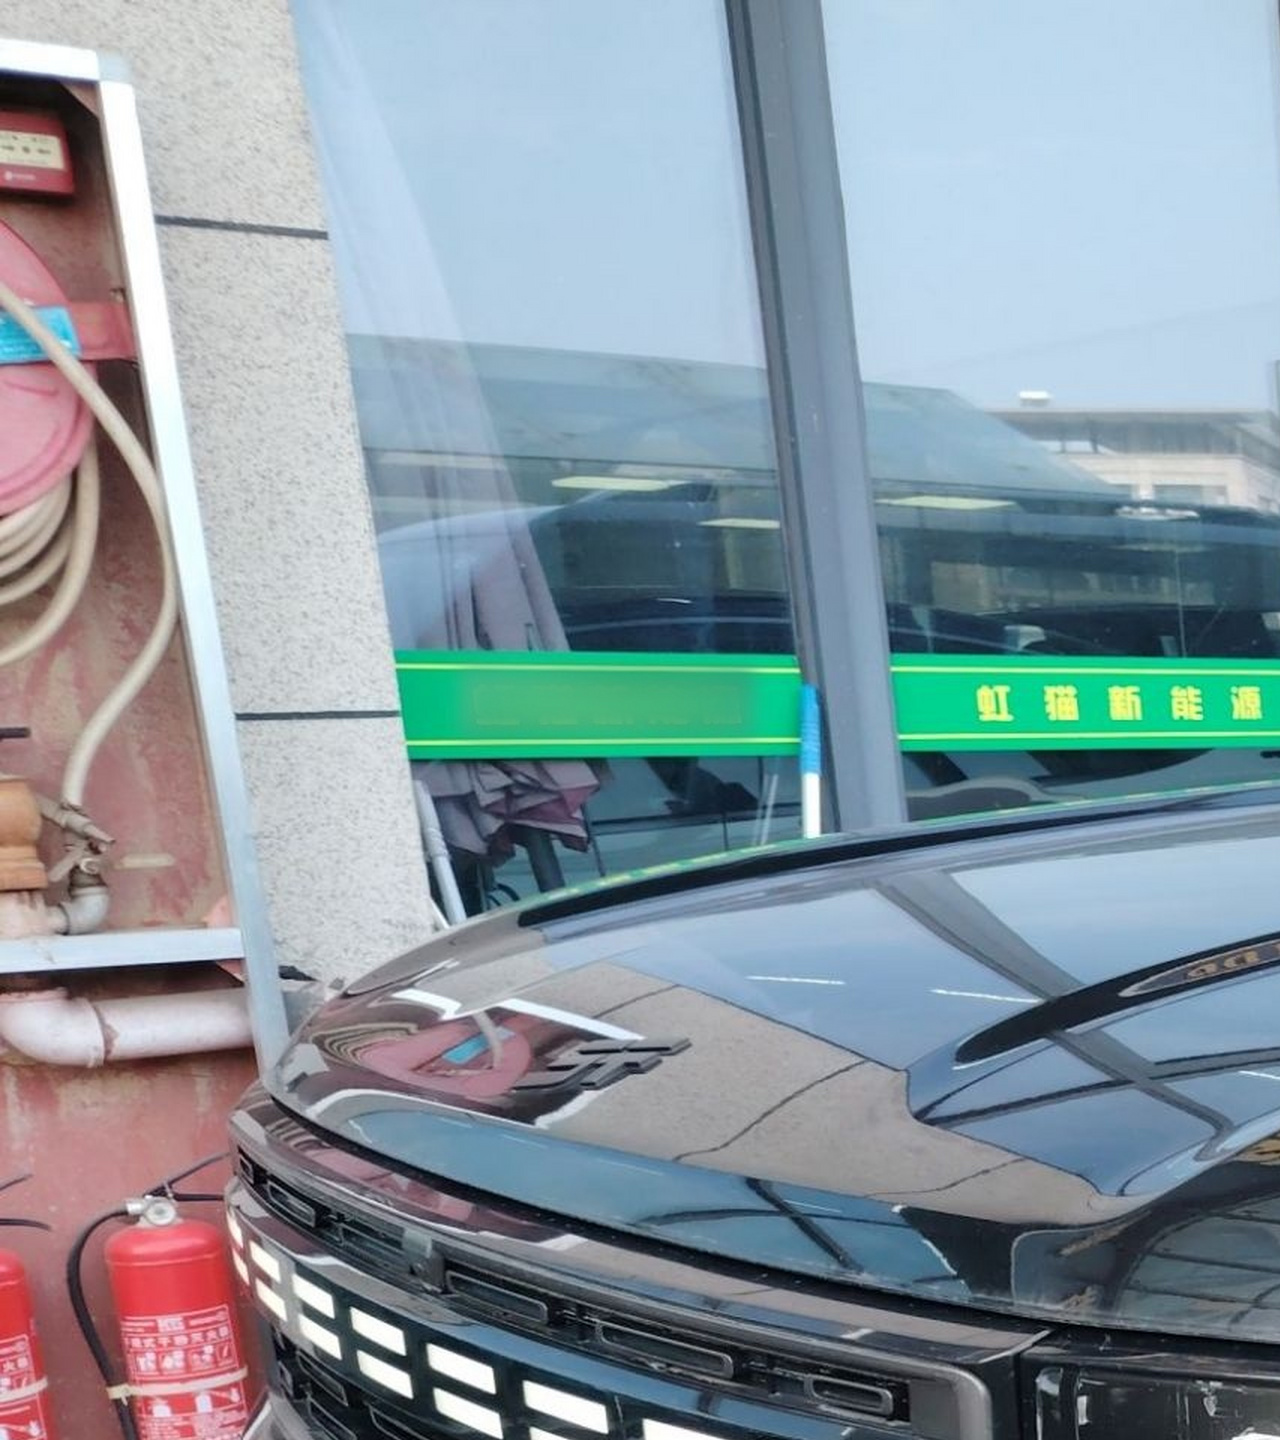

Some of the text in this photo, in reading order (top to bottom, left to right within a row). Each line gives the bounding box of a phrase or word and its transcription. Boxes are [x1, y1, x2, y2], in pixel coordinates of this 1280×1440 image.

[976, 684, 1263, 722] 虹猫新能源
